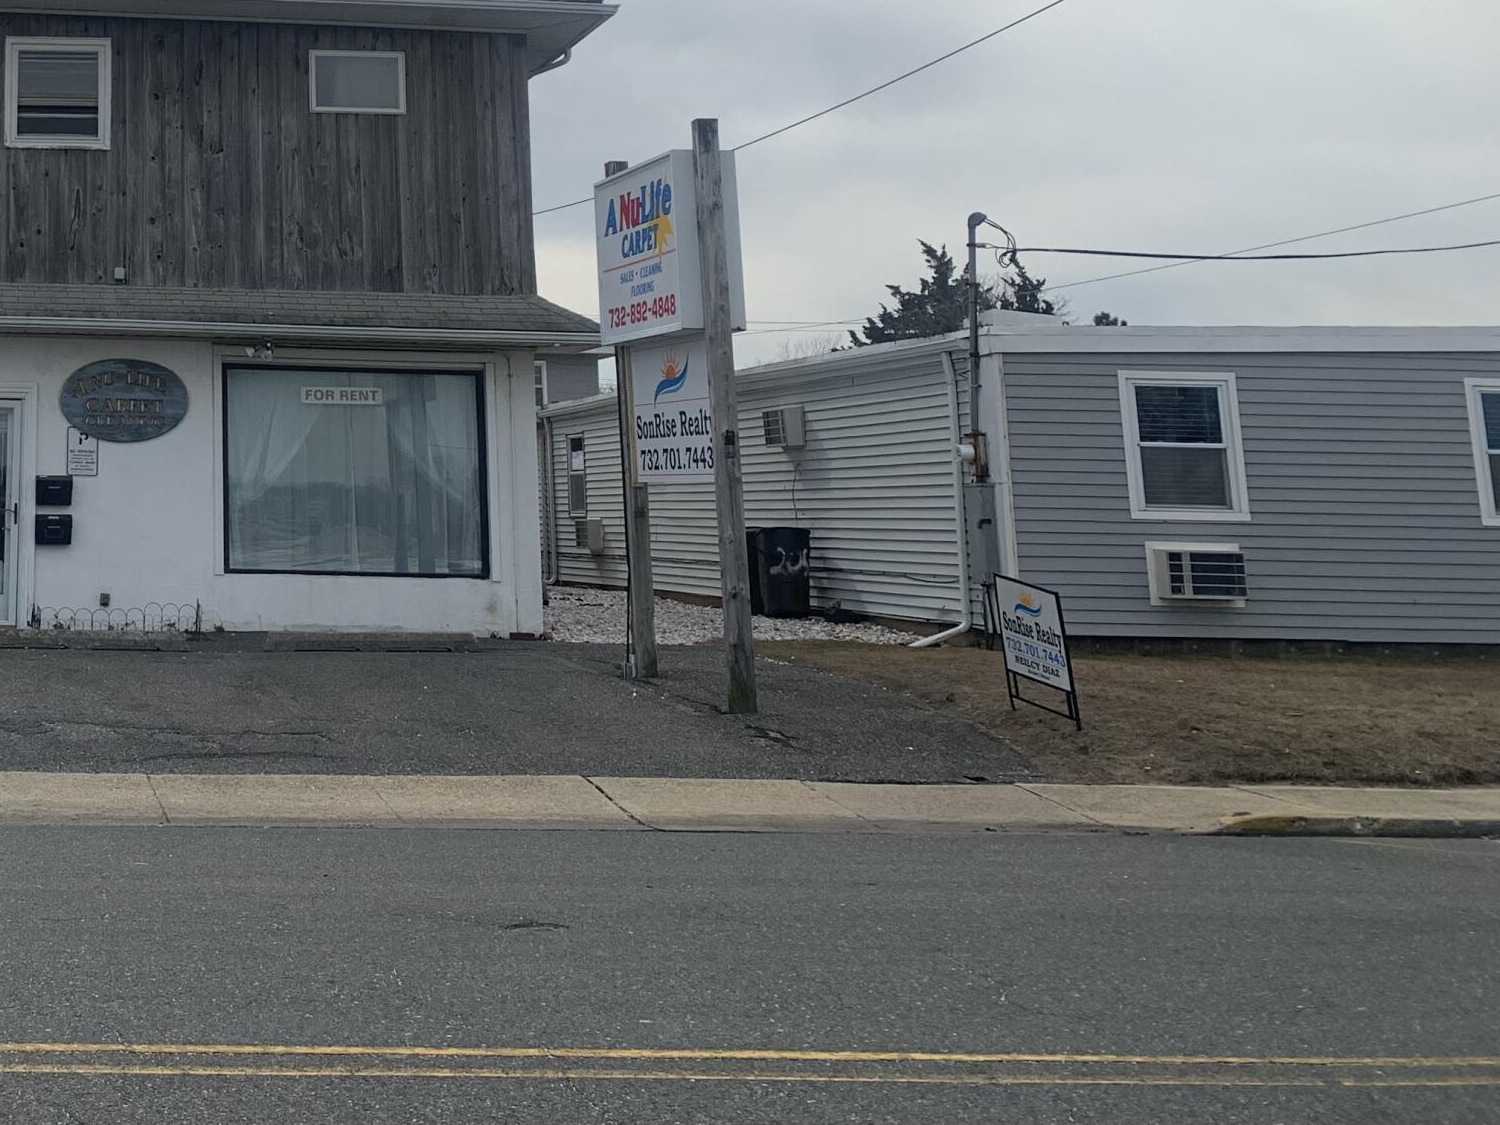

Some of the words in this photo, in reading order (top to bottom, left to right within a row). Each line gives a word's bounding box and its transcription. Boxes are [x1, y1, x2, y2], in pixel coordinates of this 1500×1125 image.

[604, 197, 618, 237] A
[622, 223, 660, 259] CARPET
[609, 293, 677, 329] 732-892-4848
[72, 378, 90, 398] A
[305, 389, 335, 401] FOR
[340, 389, 378, 402] RENT
[636, 412, 677, 440] SonRise
[640, 446, 714, 471] 732.701.7443
[1002, 611, 1035, 640] SonRise
[1035, 622, 1063, 654] Realty
[1006, 636, 1066, 668] 732.701.7443
